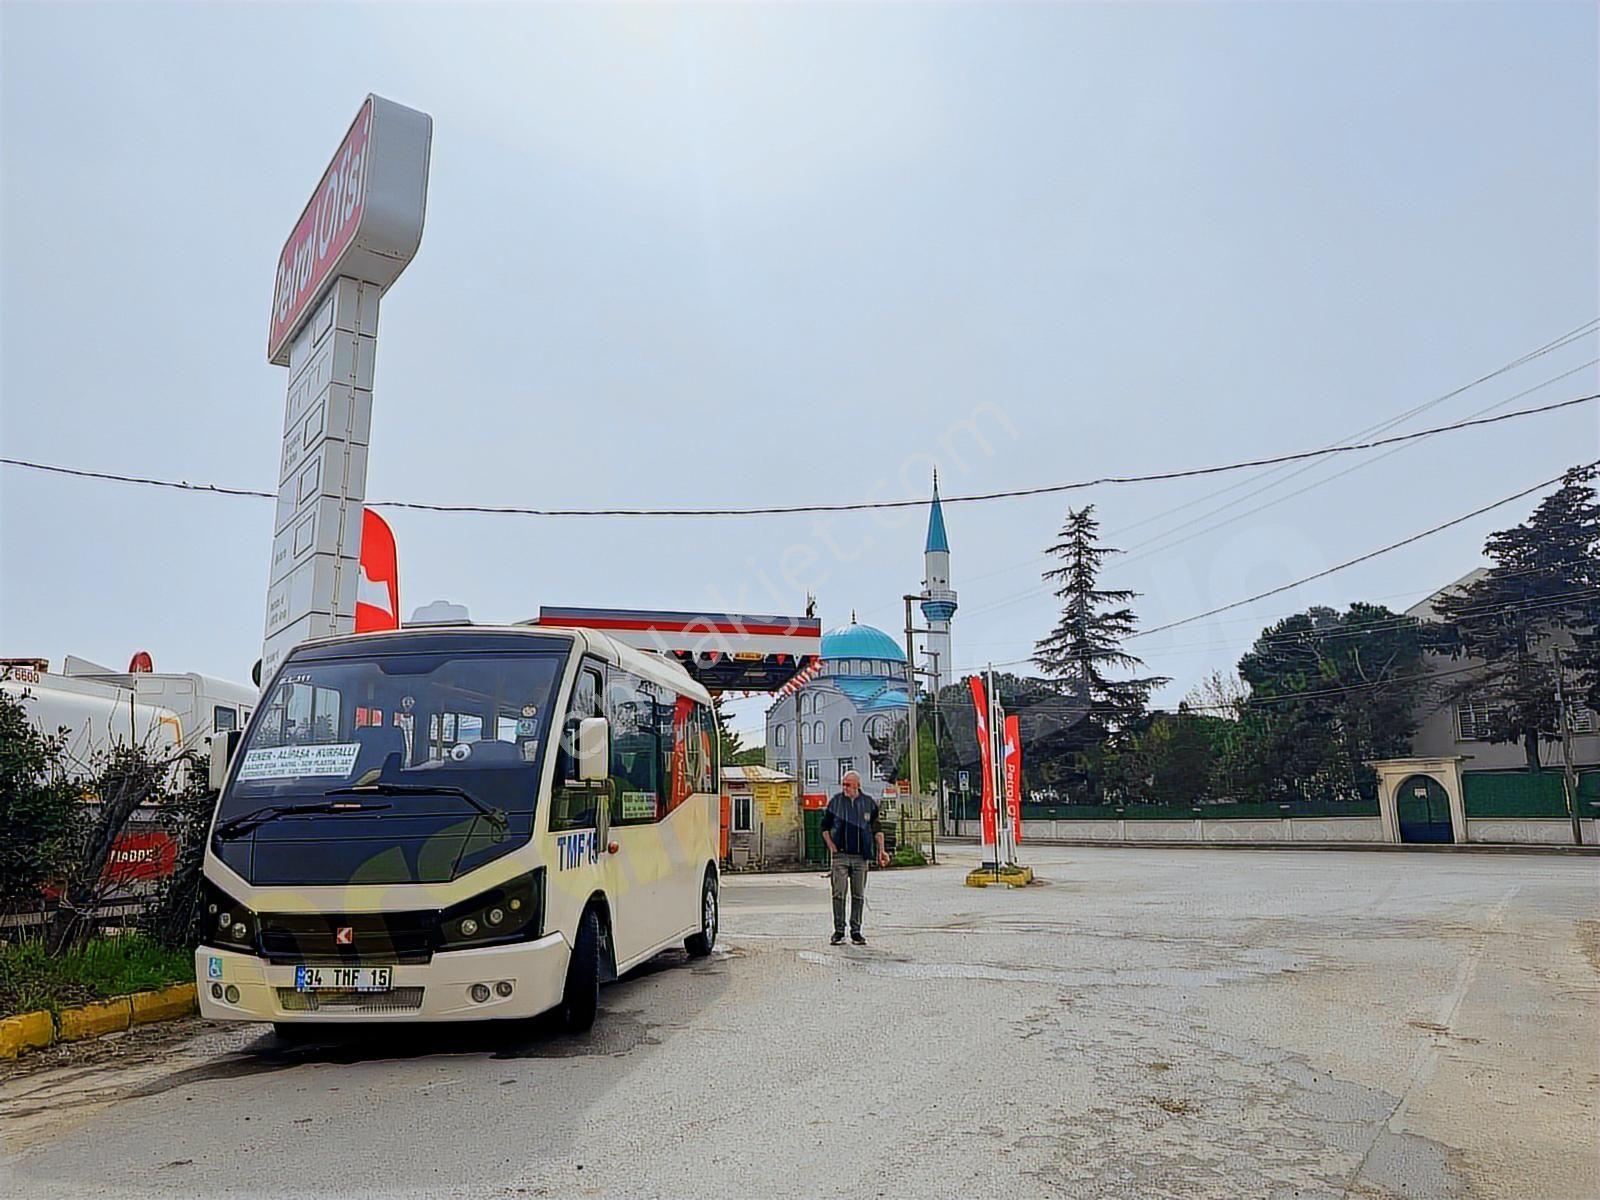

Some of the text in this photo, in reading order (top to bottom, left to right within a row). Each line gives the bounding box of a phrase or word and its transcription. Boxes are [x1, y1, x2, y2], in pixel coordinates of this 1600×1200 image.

[277, 114, 371, 324] Petrol Ofisi
[1007, 763, 1016, 803] Petrol
[557, 833, 585, 872] TMF
[305, 969, 322, 986] 34
[333, 969, 360, 986] TMF
[371, 969, 388, 986] 15
